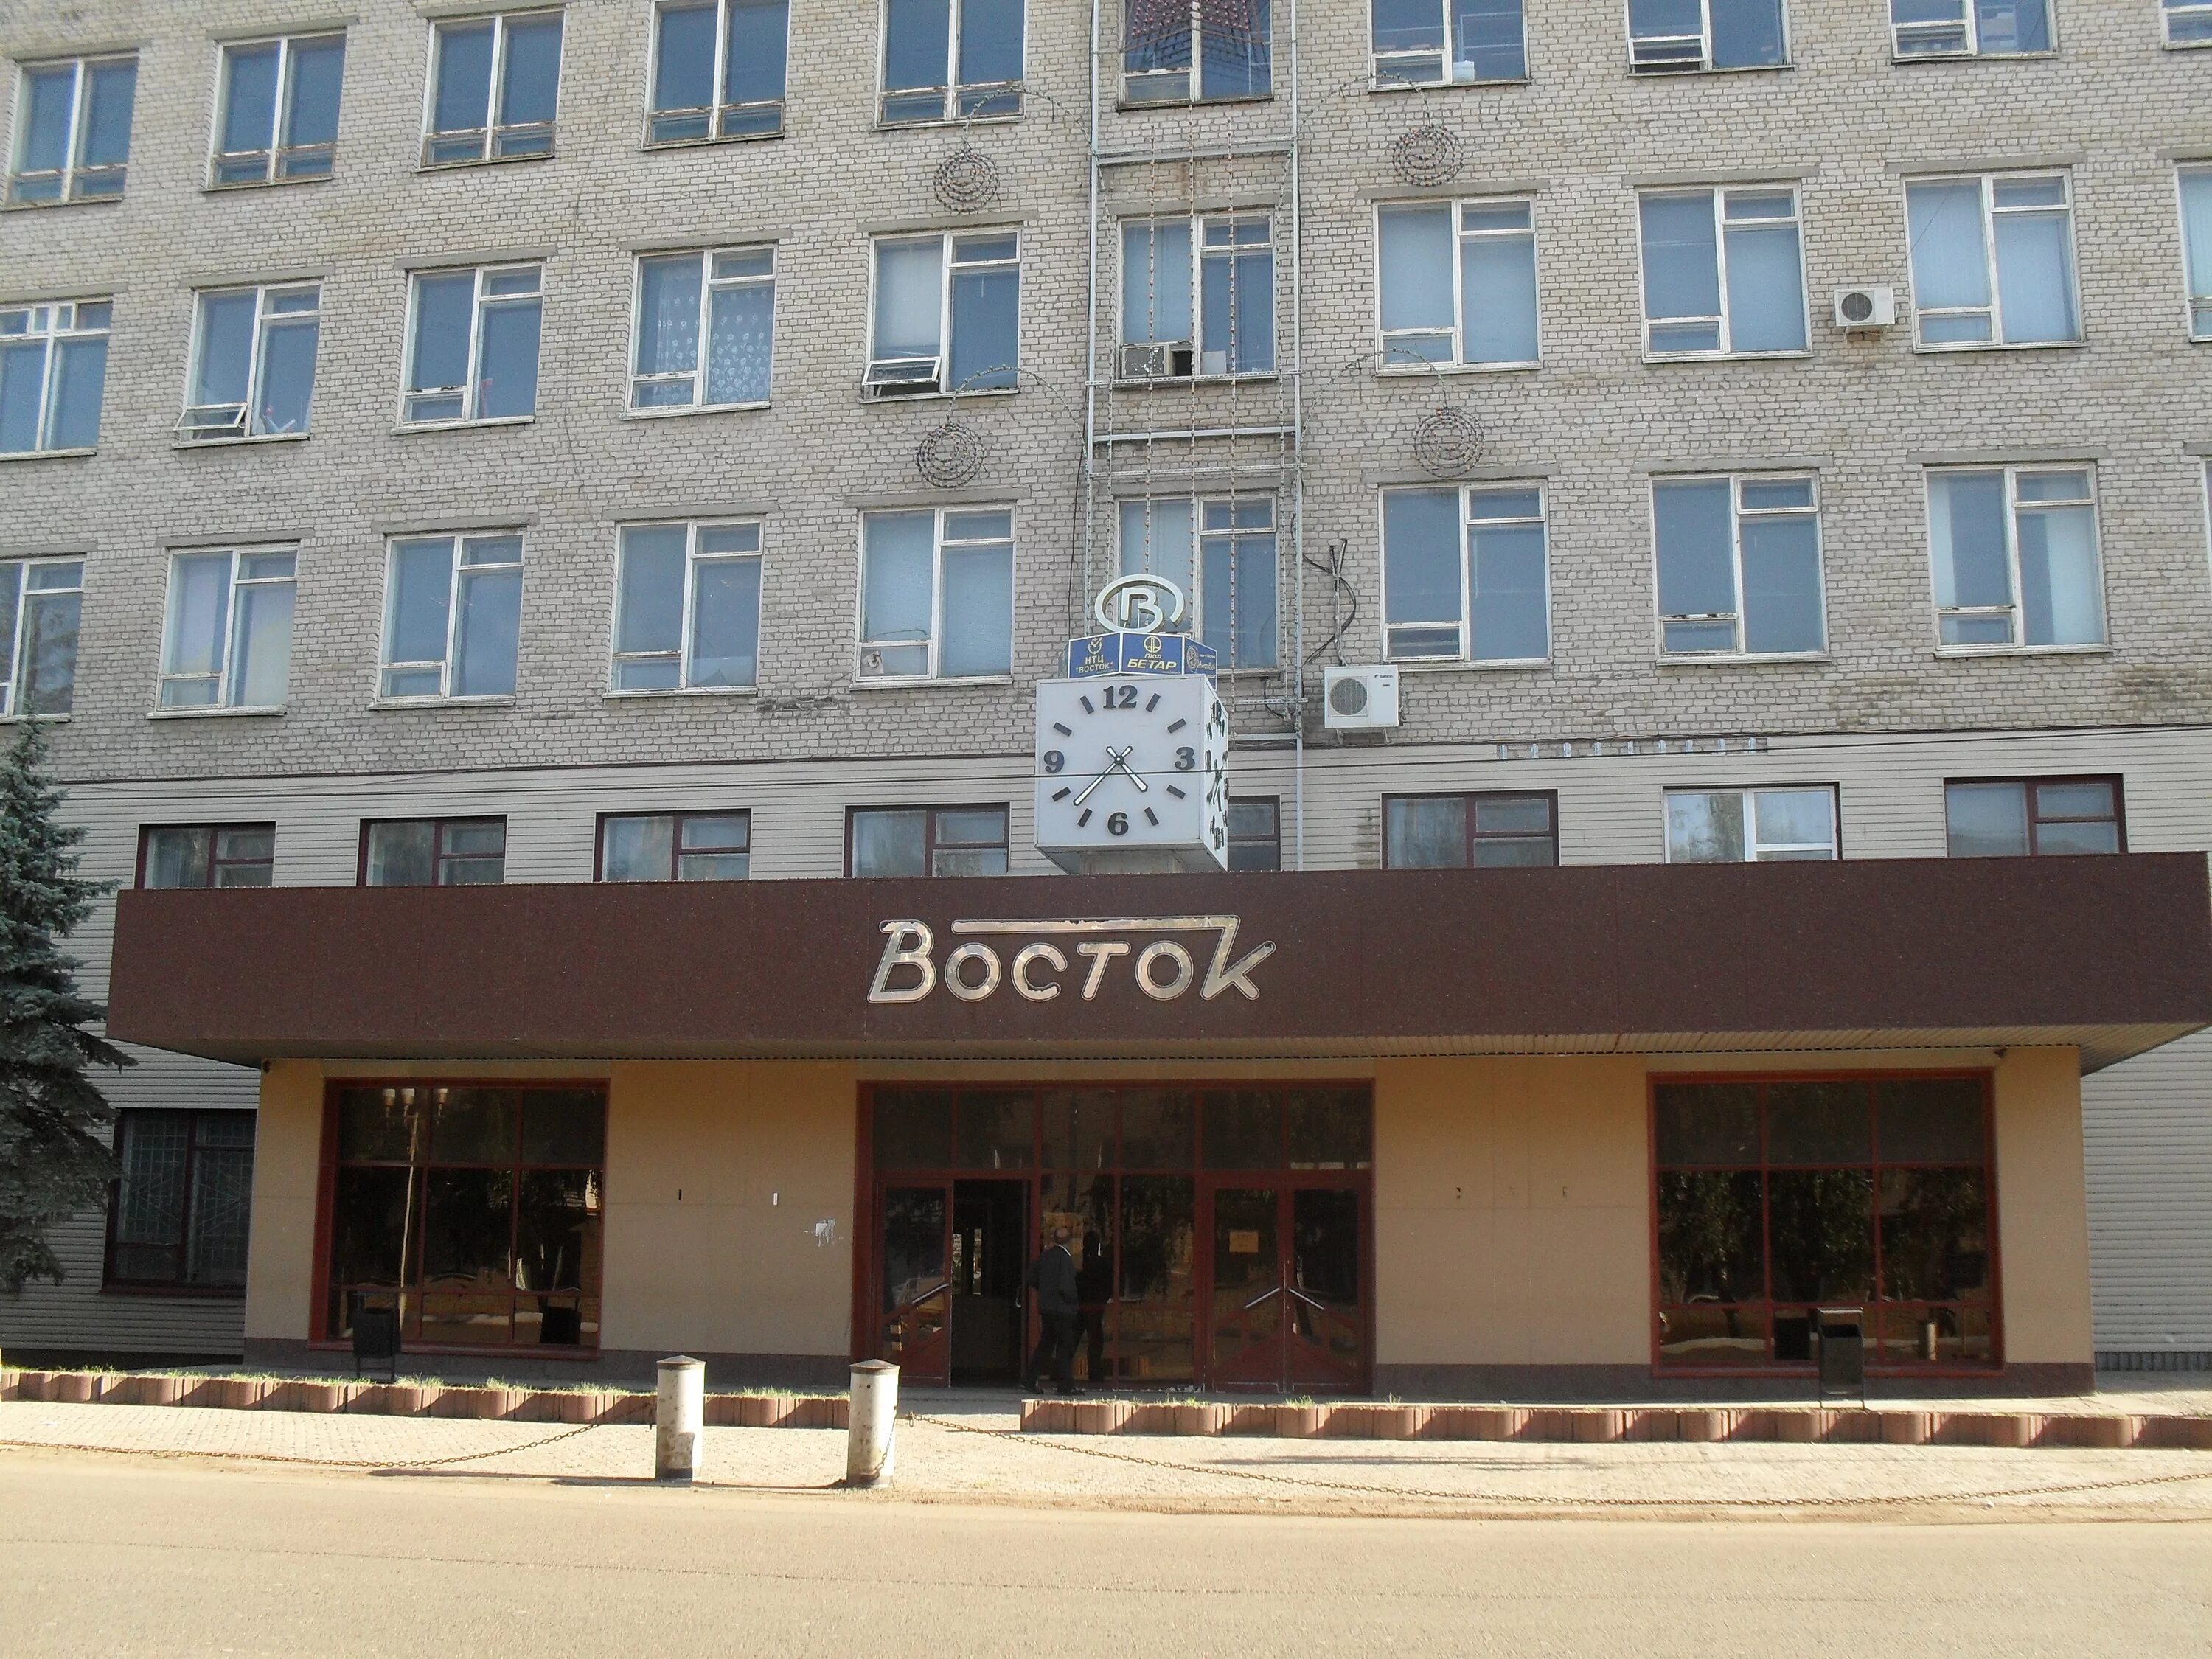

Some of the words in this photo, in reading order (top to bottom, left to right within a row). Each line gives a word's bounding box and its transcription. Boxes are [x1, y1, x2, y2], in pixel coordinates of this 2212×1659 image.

[1085, 654, 1104, 665] НТЦ
[1127, 658, 1178, 670] БЕТАР
[1103, 684, 1138, 709] 12
[1043, 750, 1065, 773] 9
[1175, 746, 1195, 771] 3
[1107, 812, 1129, 835] 6
